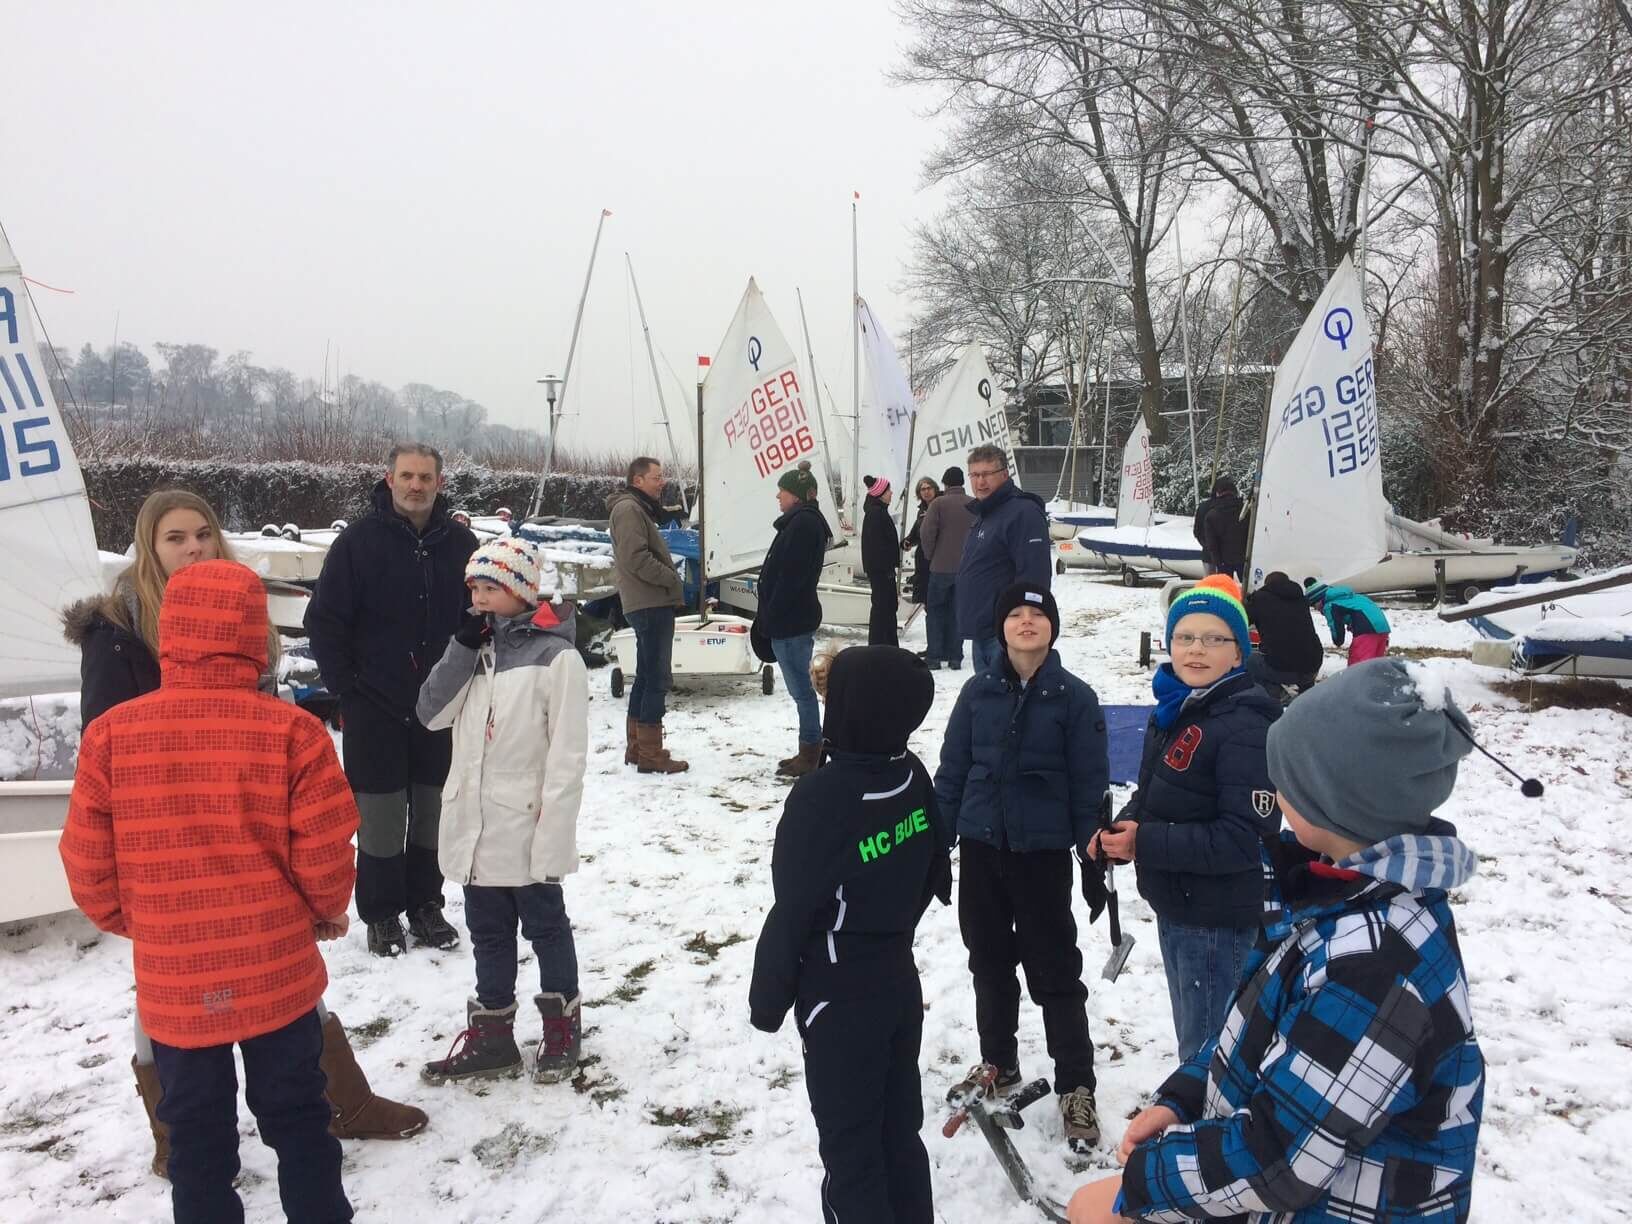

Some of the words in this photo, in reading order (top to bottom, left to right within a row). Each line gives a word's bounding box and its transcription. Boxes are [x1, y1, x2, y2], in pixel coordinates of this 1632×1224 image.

[751, 370, 800, 415] GER
[1336, 358, 1373, 405] GER
[977, 409, 1006, 442] NED
[754, 425, 814, 479] 11986
[1258, 793, 1270, 811] R
[859, 831, 891, 863] HC
